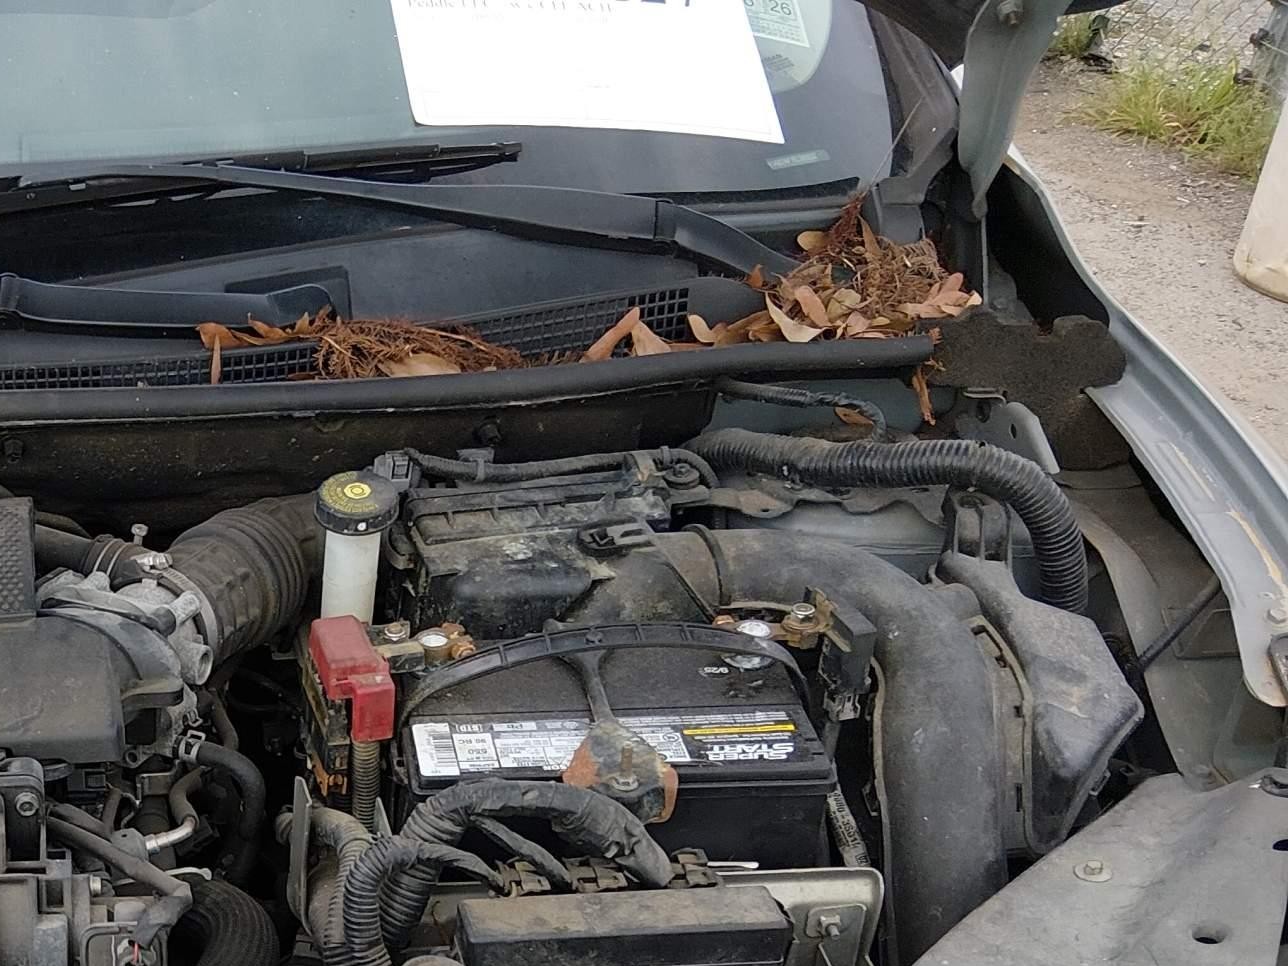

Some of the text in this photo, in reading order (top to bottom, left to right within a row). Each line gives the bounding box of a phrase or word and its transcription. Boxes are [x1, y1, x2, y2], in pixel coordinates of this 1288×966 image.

[769, 0, 792, 15] 26
[712, 743, 794, 753] START
[707, 752, 788, 760] SUPER
